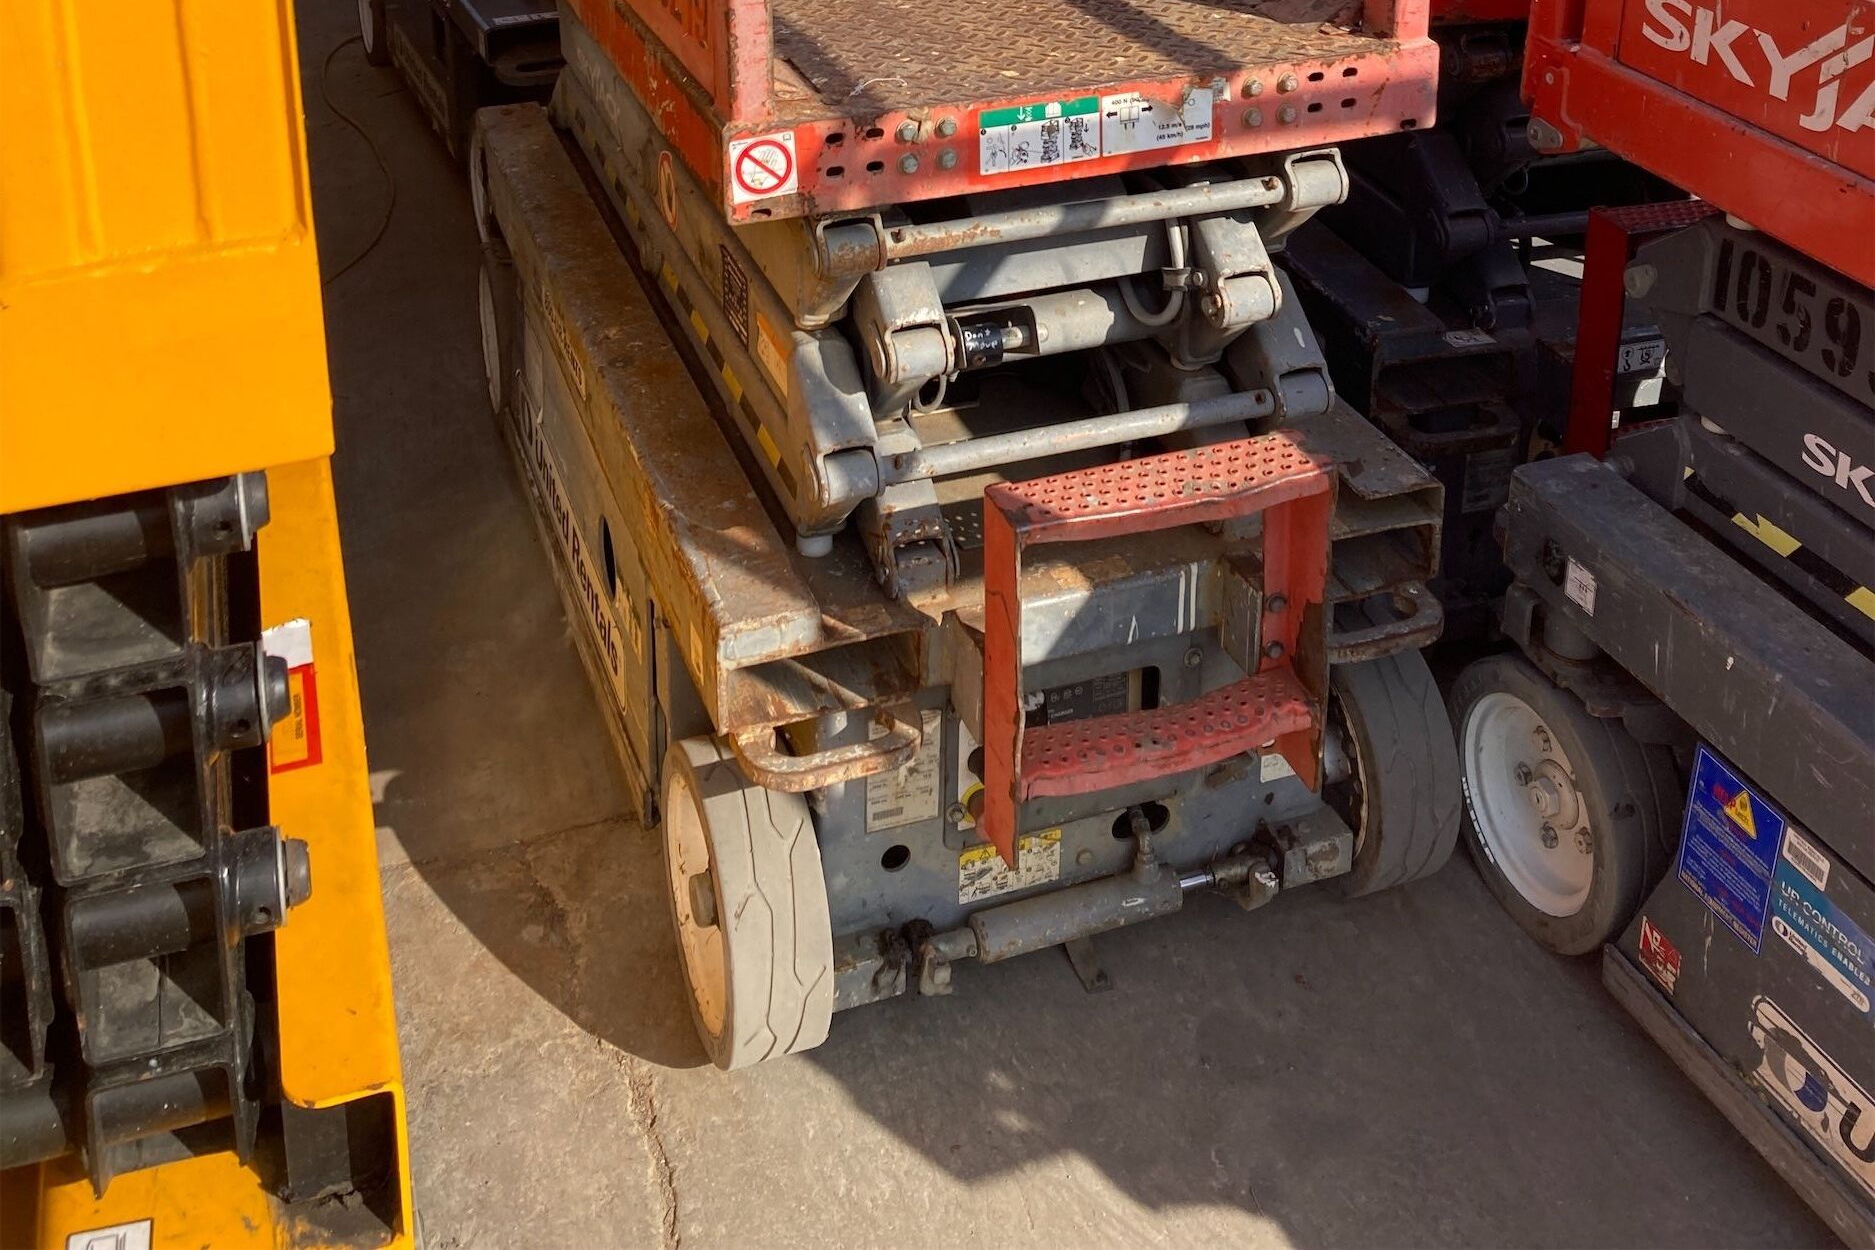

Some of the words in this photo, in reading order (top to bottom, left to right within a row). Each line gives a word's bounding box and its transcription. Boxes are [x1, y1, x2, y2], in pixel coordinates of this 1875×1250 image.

[1713, 238, 1875, 395] 1059
[535, 437, 569, 545] United
[571, 535, 619, 677] Rentals
[1778, 899, 1829, 949] TELEMATICS
[1831, 947, 1871, 986] ENABLED
[1803, 901, 1865, 965] CONTROL
